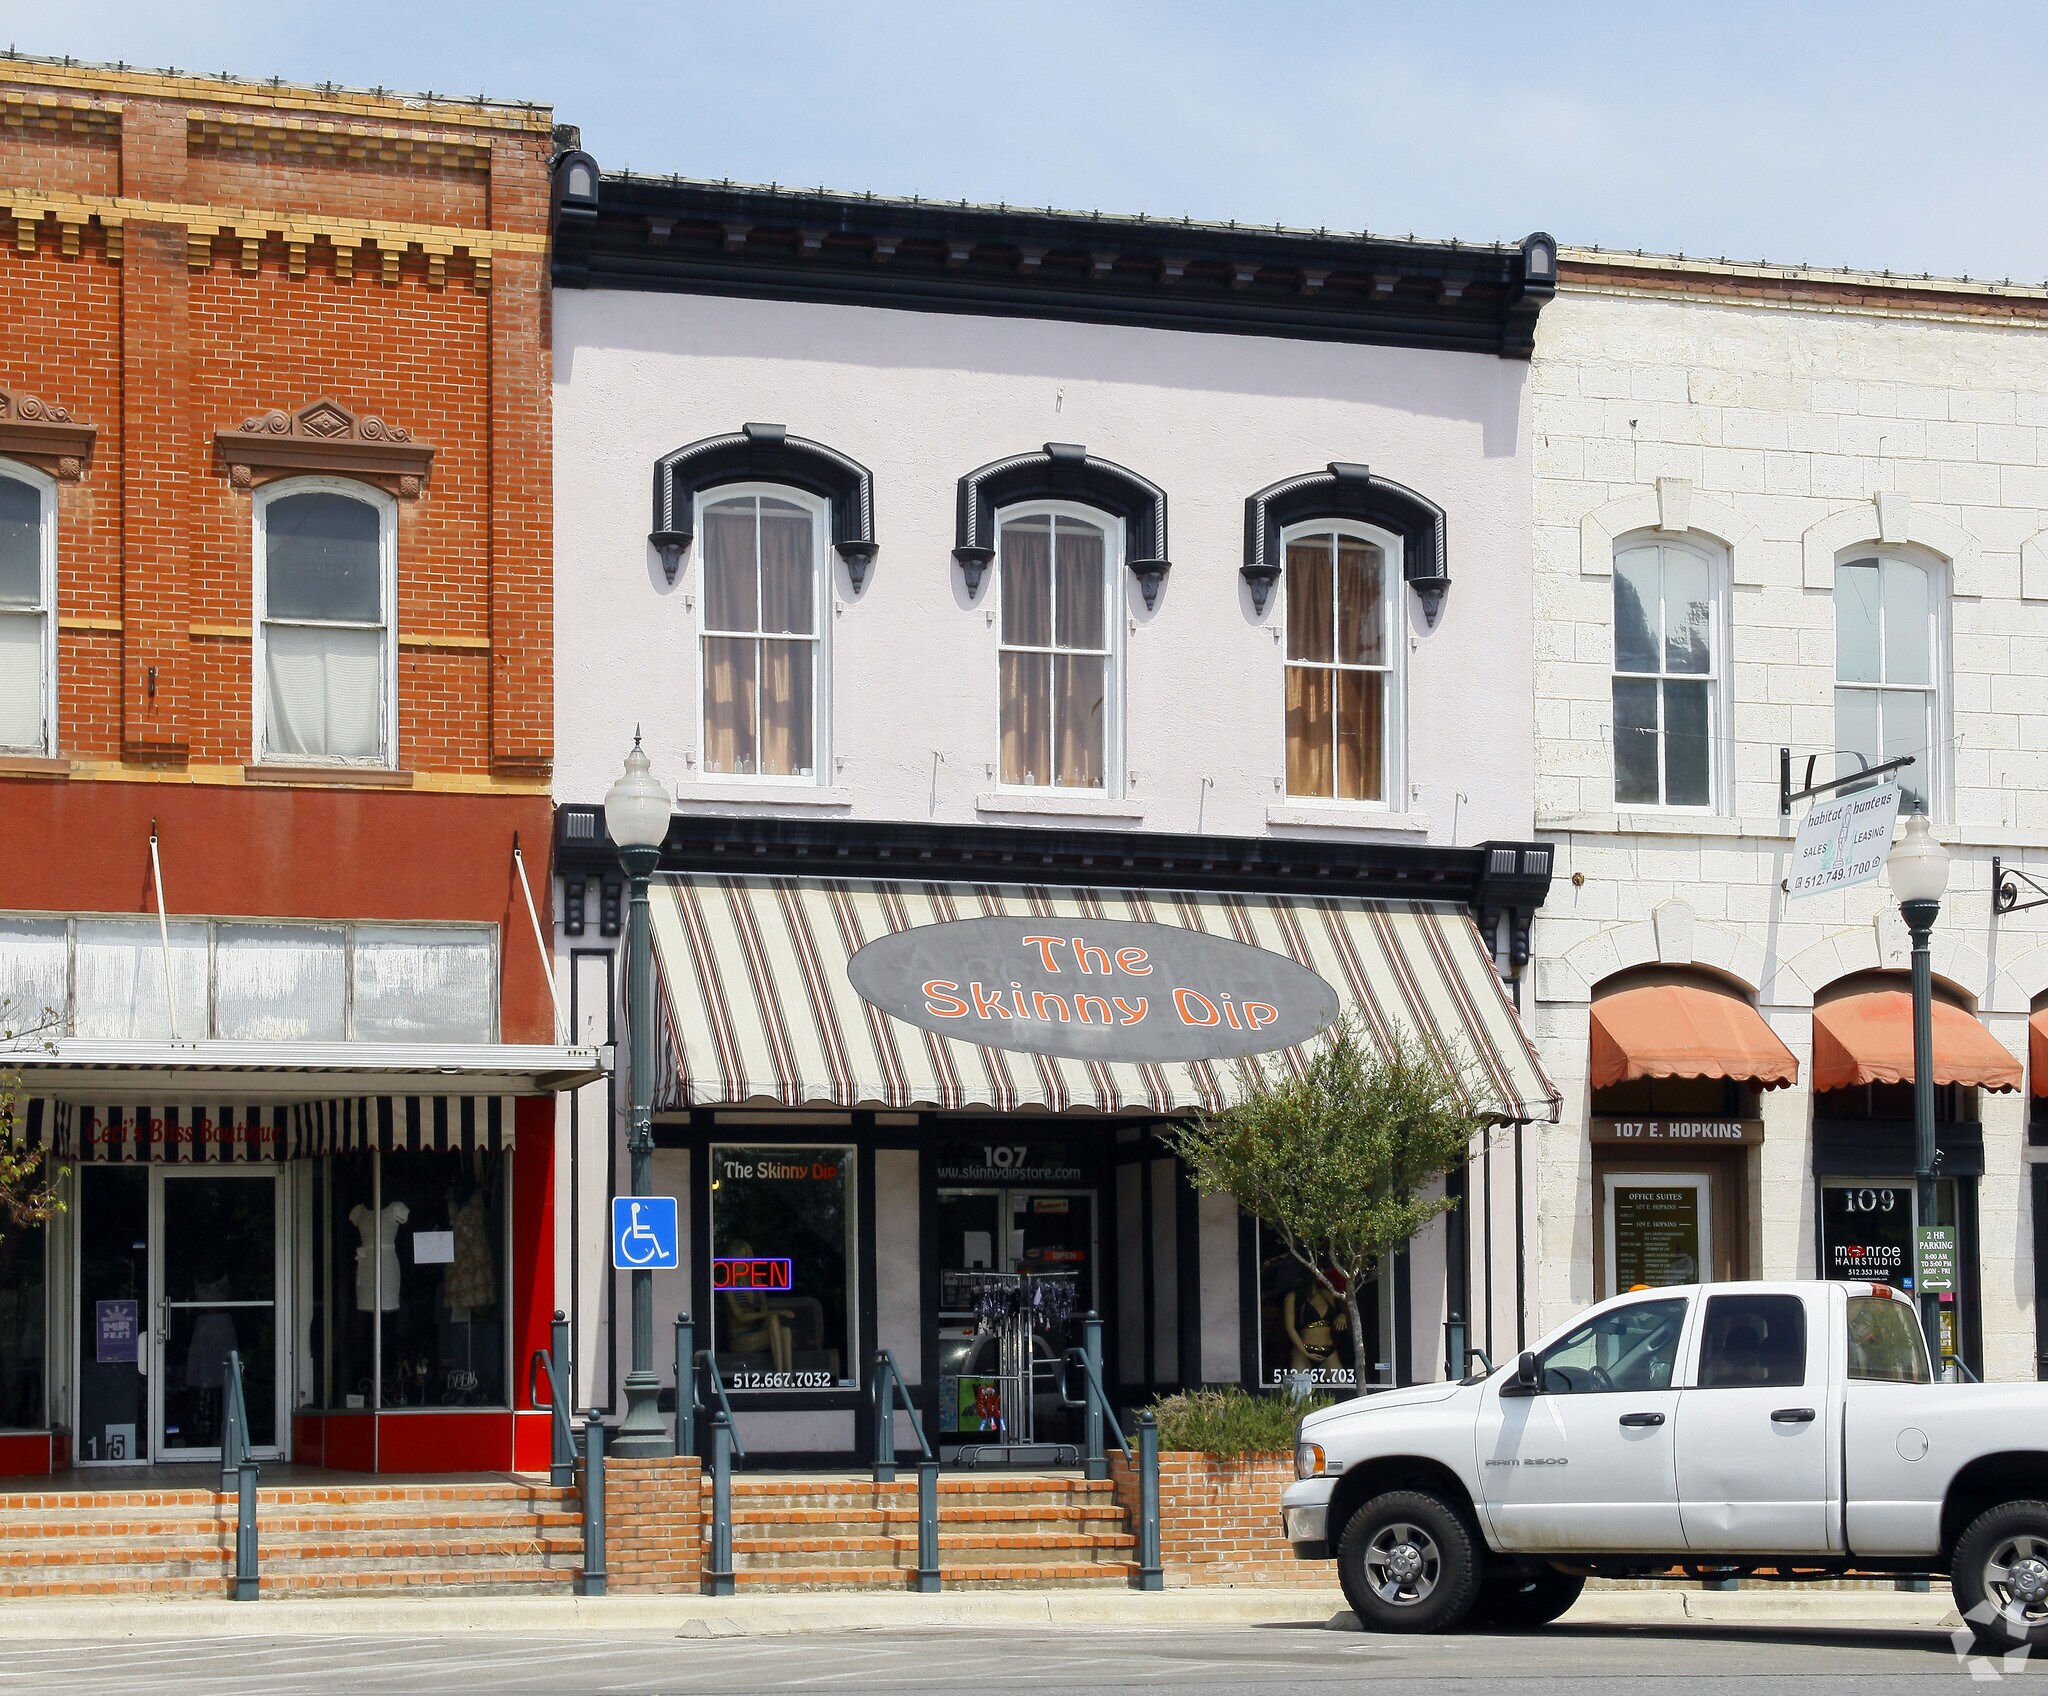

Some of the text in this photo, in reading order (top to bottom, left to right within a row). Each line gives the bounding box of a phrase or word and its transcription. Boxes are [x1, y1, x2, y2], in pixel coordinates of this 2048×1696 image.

[1808, 807, 1842, 827] habitat
[1854, 826, 1885, 844] LEASING
[1803, 843, 1828, 858] SALES
[1804, 860, 1871, 889] 512.749.1700
[1021, 935, 1153, 977] The
[921, 979, 1279, 1032] Skinny Dip
[86, 1118, 281, 1147] Ceci's Bliss Boutique
[1614, 1123, 1742, 1138] 107 E. HOPKINS
[984, 1146, 1028, 1168] 107
[724, 1161, 838, 1180] The Skinny Dip
[1845, 1188, 1895, 1212] 109
[1933, 1232, 1945, 1240] HR
[1919, 1242, 1953, 1250] PARKING
[714, 1261, 788, 1287] OPEN
[1848, 1268, 1873, 1276] 512.353
[103, 1331, 130, 1339] FEST
[448, 1371, 476, 1389] OPEN
[733, 1372, 831, 1388] 512.667.7032
[1523, 1458, 1569, 1466] 2500
